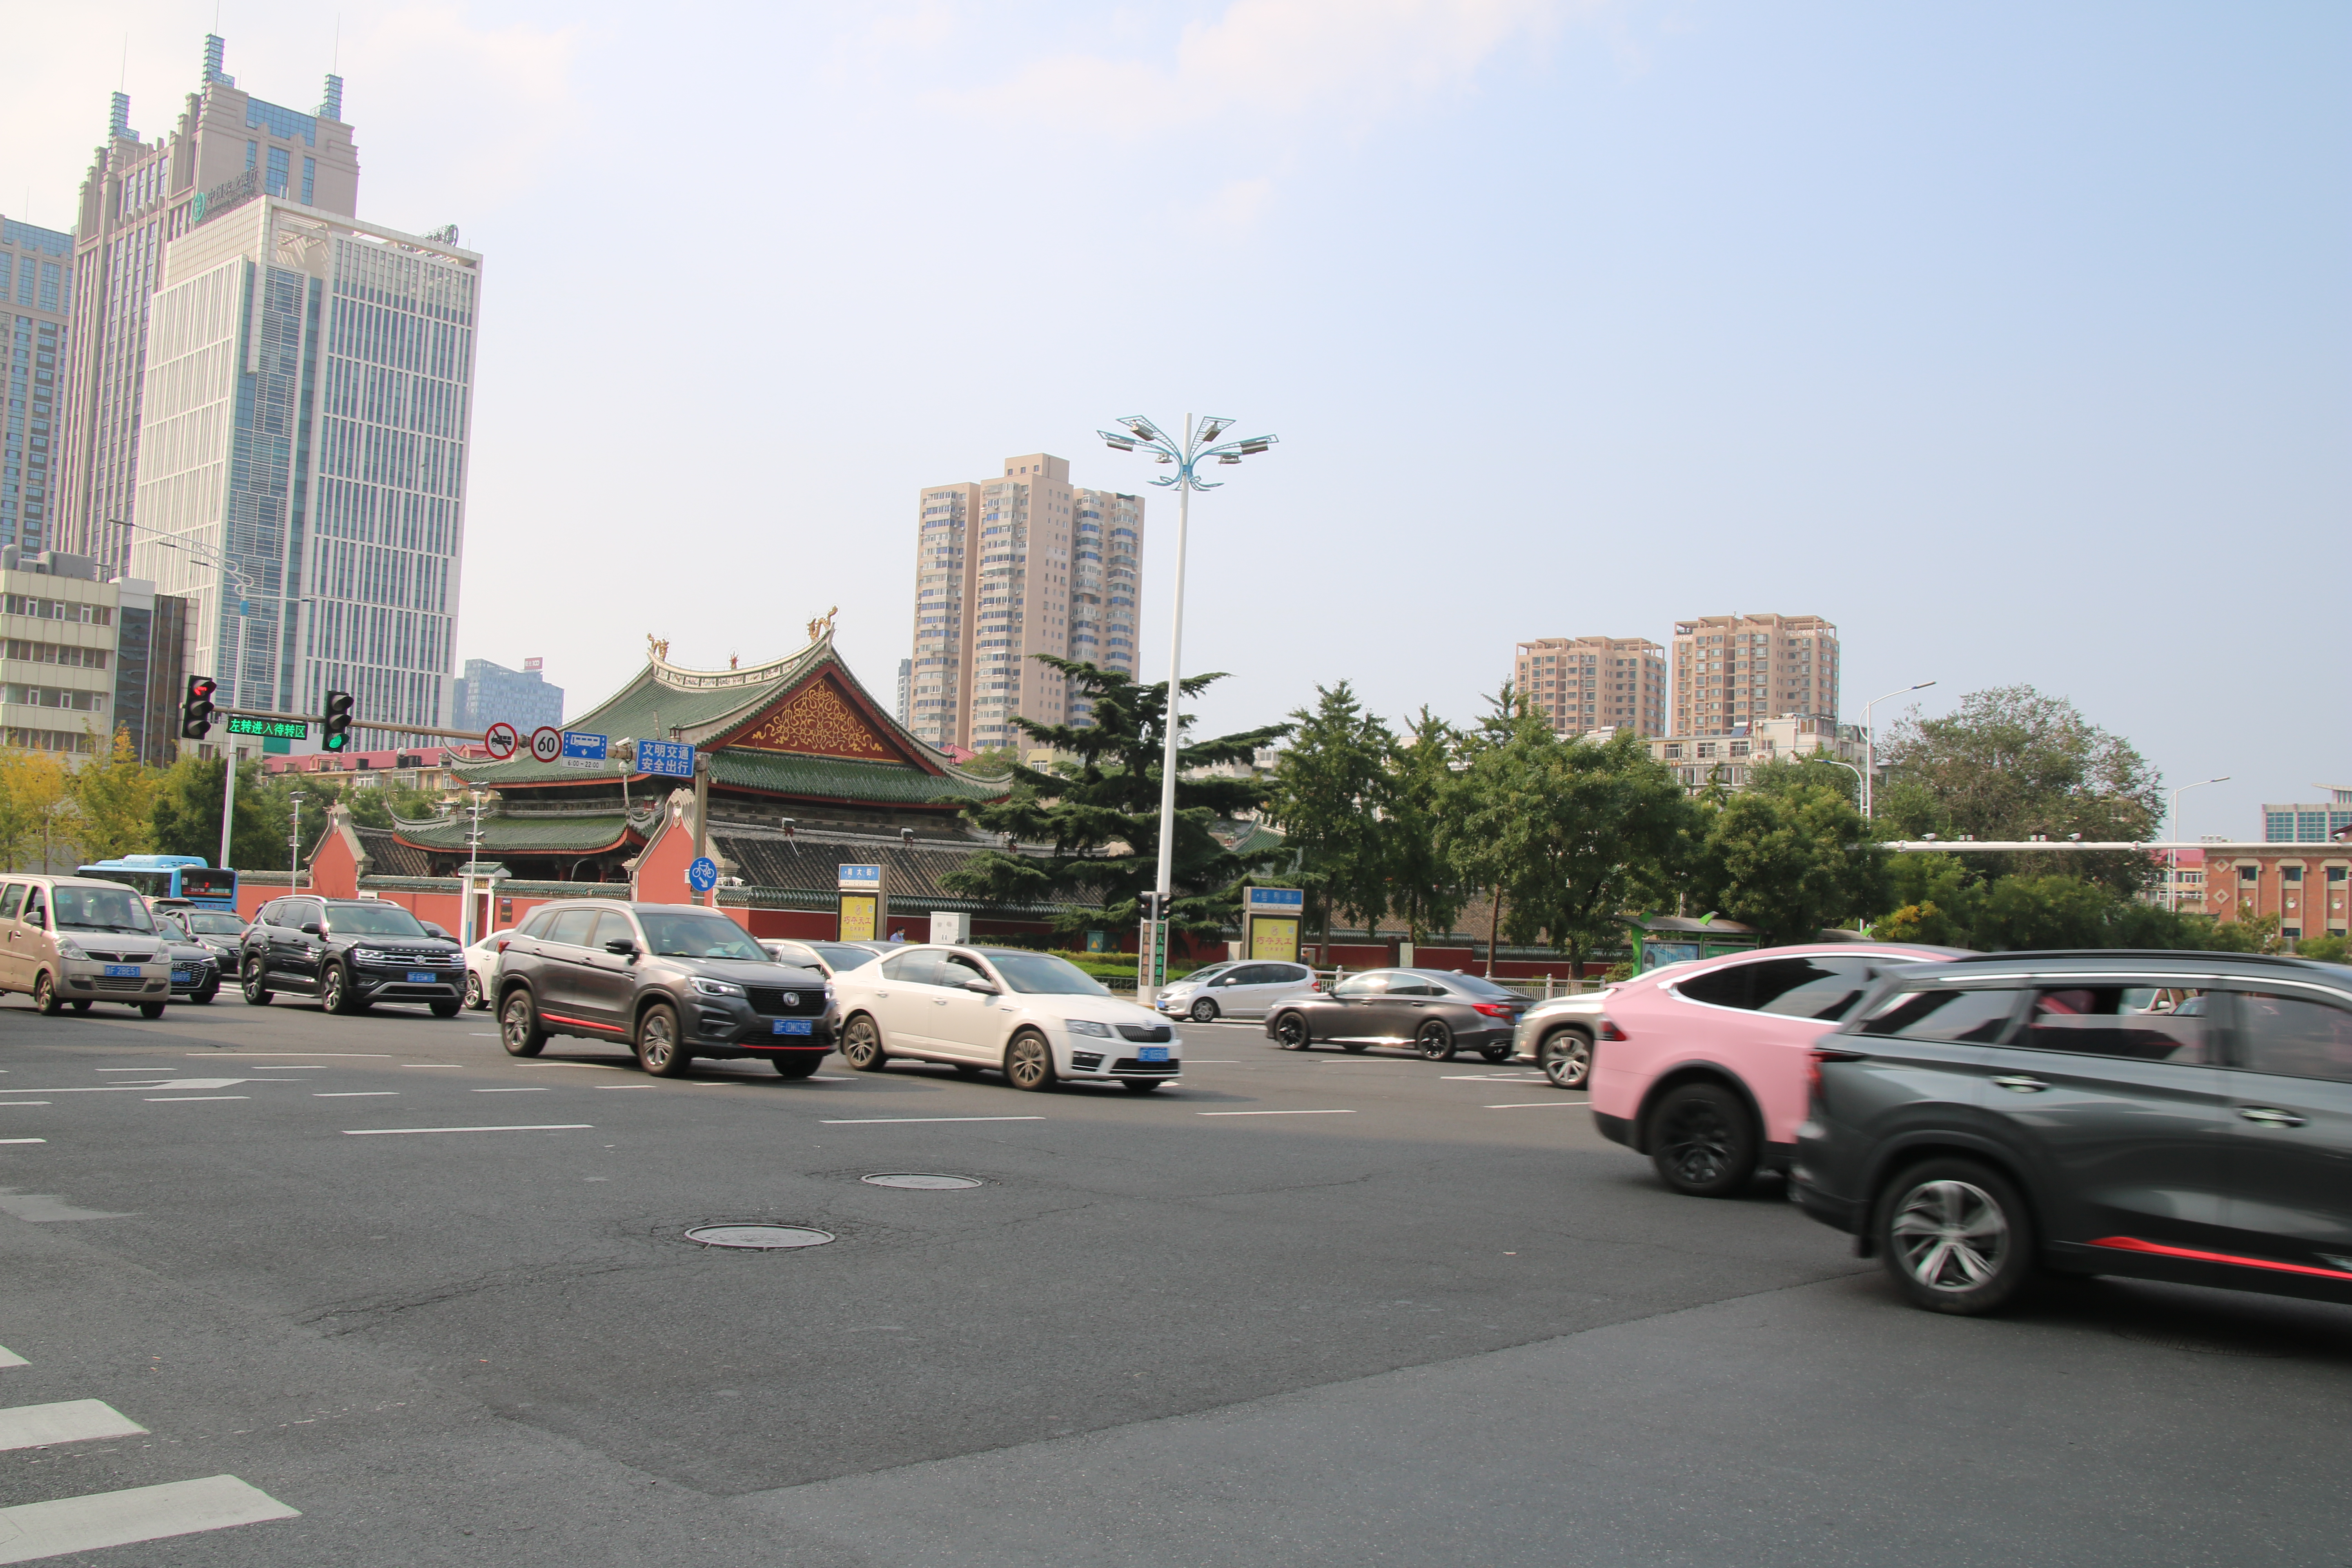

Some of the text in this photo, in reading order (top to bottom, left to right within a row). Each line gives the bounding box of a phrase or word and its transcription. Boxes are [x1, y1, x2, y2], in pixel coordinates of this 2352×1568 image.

[229, 719, 306, 738] 左转进入待转区
[538, 737, 555, 752] 60
[643, 743, 689, 760] 文明交通
[642, 757, 688, 774] 安全出行
[848, 868, 871, 876] 南大街
[844, 916, 871, 924] 巧夺天工
[1256, 936, 1292, 945] 巧夺天工
